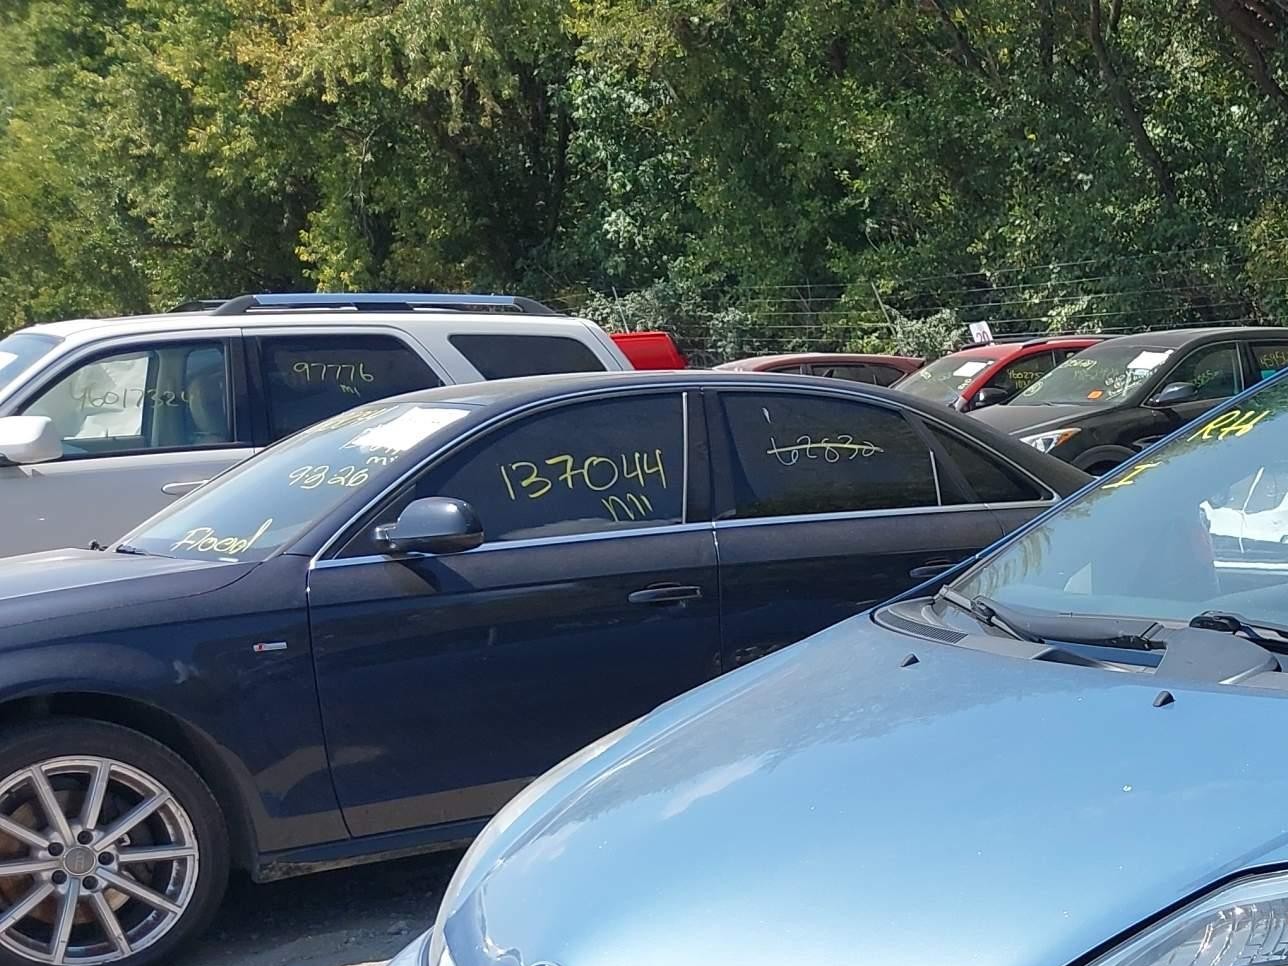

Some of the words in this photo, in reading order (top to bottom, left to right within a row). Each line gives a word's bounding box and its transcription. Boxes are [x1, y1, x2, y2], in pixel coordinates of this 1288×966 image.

[293, 362, 374, 382] 97776
[500, 449, 667, 500] 137044
[169, 518, 272, 555] Flood
